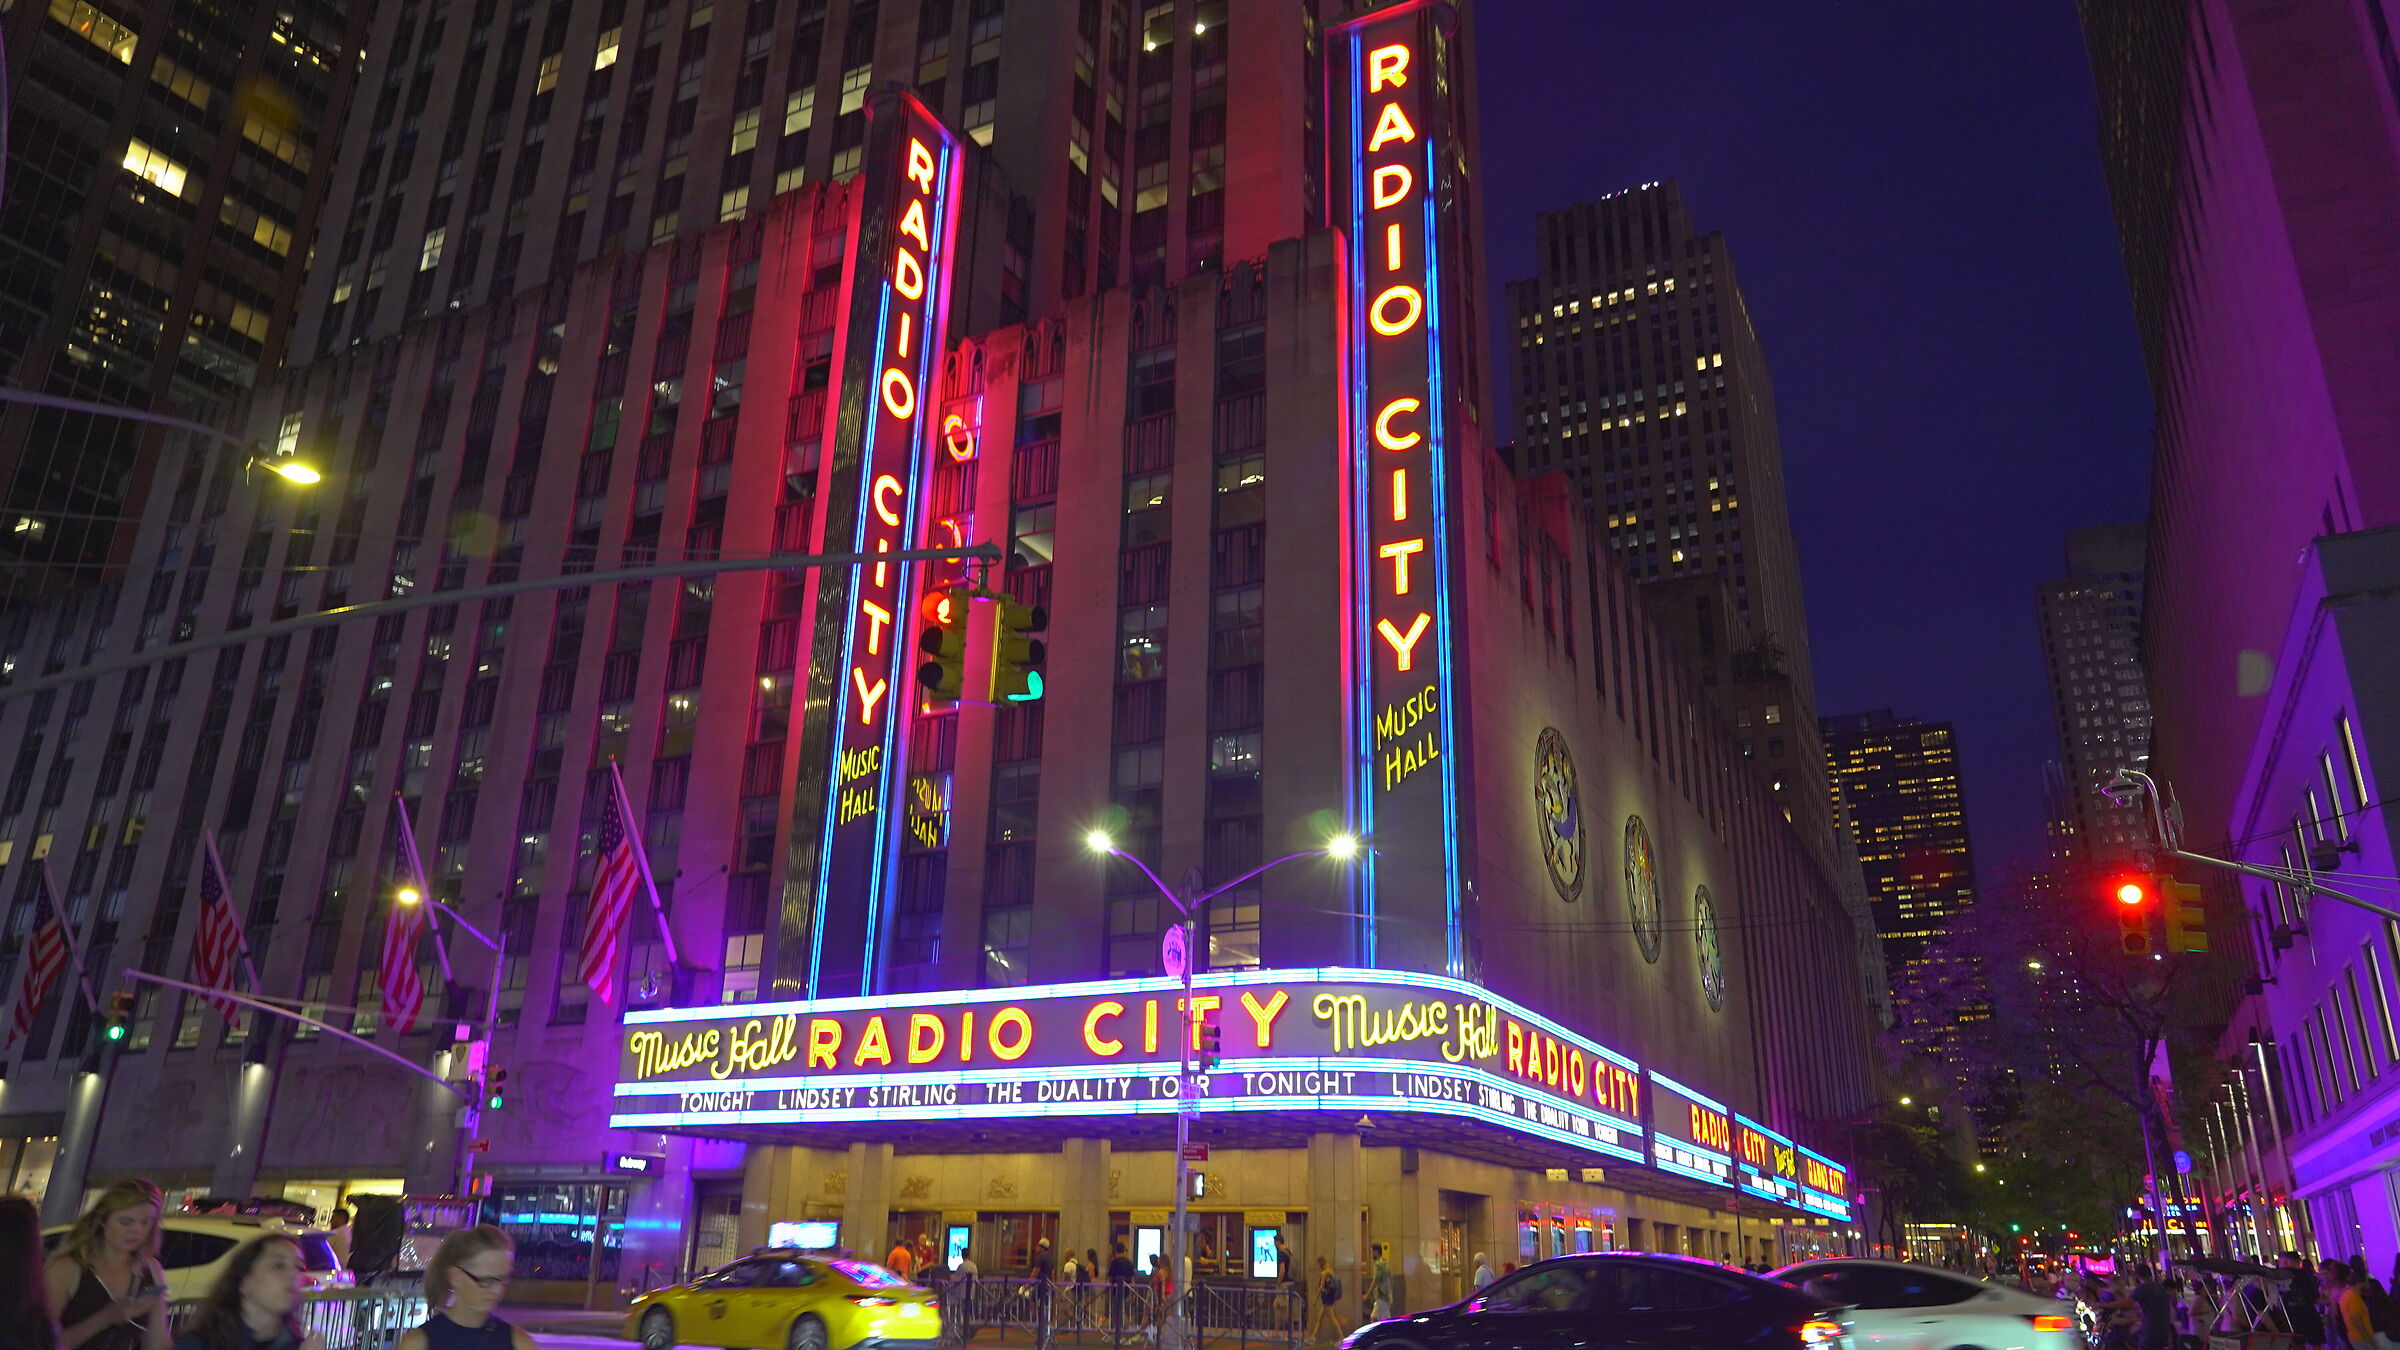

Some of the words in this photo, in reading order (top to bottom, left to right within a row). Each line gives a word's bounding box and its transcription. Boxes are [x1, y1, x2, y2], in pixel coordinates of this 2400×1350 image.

[1368, 44, 1422, 336] RADIO
[881, 136, 935, 419] RADIO
[1375, 397, 1431, 671] CITY
[853, 474, 902, 725] CITY
[1377, 685, 1438, 751] MUSIC
[840, 745, 880, 787] MUSIC
[1385, 732, 1439, 791] HALL
[840, 786, 876, 825] HALL
[630, 1028, 719, 1080] Music
[710, 1014, 797, 1080] Hall
[808, 1006, 1033, 1070] RADIO
[1084, 990, 1289, 1056] CITY
[1313, 993, 1448, 1053] Music
[1441, 1001, 1499, 1062] Hall
[1506, 1019, 1585, 1098] RADIO
[1594, 1060, 1640, 1117] CITY
[680, 1091, 755, 1113] TONIGHT
[778, 1087, 855, 1109] LINDSEY
[868, 1084, 957, 1106] STIRLING
[986, 1081, 1023, 1103] THE
[1037, 1076, 1129, 1101] DUALITY
[1149, 1073, 1210, 1098] TOR
[1243, 1072, 1355, 1096] TONIGHT
[1392, 1073, 1471, 1102] LINDSEY
[1522, 1100, 1538, 1121] THE
[1690, 1103, 1730, 1152] RADIO
[1743, 1127, 1767, 1166] CITY
